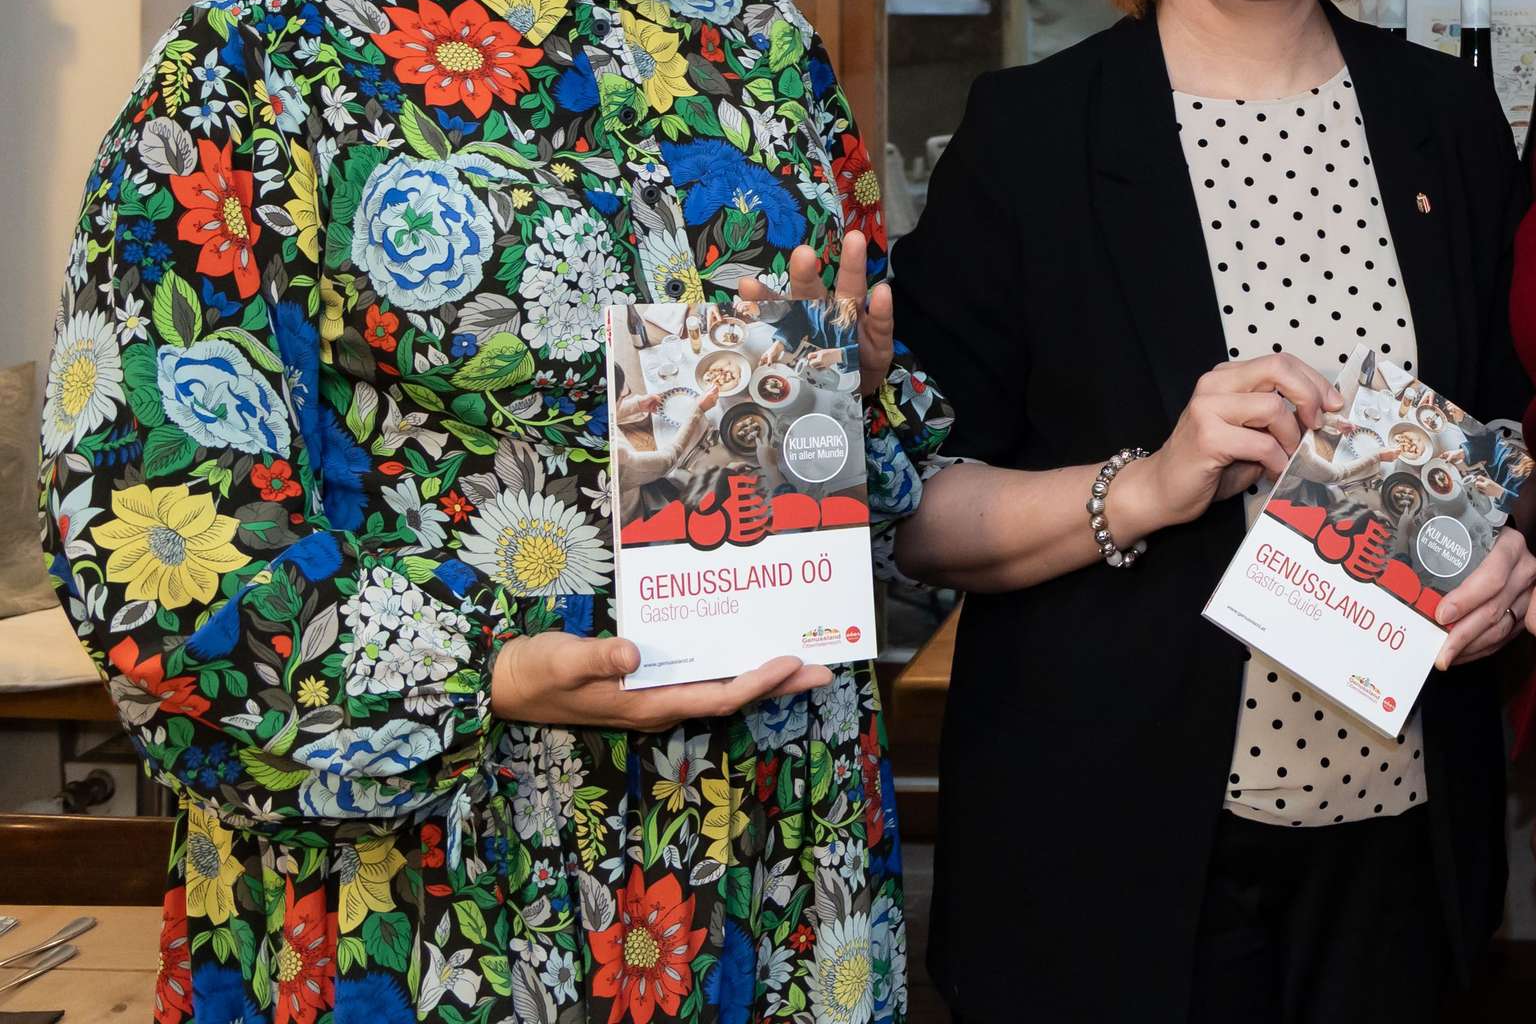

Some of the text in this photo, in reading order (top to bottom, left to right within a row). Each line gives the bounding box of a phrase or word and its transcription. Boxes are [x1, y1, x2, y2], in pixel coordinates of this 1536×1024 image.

[789, 435, 844, 450] KULINARIK
[1425, 525, 1469, 560] KULINARIK
[639, 553, 833, 601] GENUSSLAND OÖ
[1245, 563, 1323, 622] Gastro-Guide
[1255, 543, 1375, 631] GENUSSLAND
[1377, 621, 1407, 651] OÖ
[640, 596, 740, 624] Gastro-Guide
